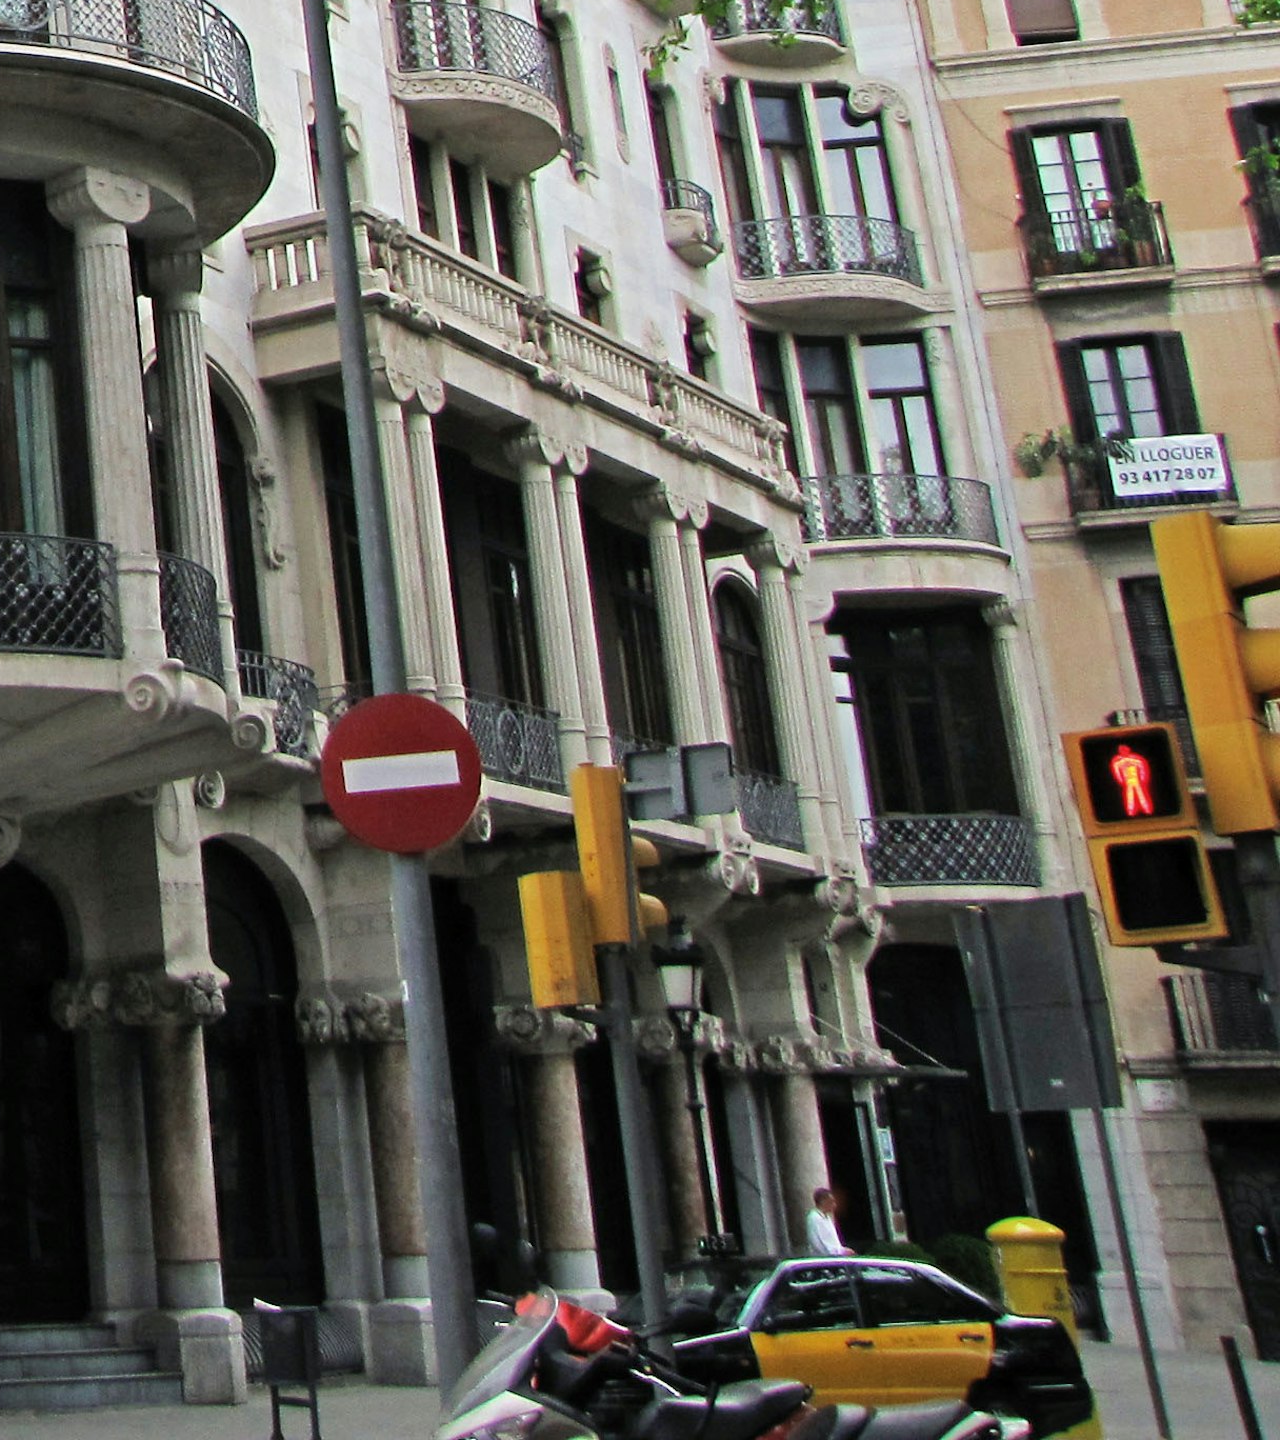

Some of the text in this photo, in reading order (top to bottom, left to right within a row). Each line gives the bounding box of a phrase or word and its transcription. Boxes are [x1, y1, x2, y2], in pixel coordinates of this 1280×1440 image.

[1140, 447, 1214, 462] LLOGUER
[1120, 467, 1215, 484] 93 417 28 07
